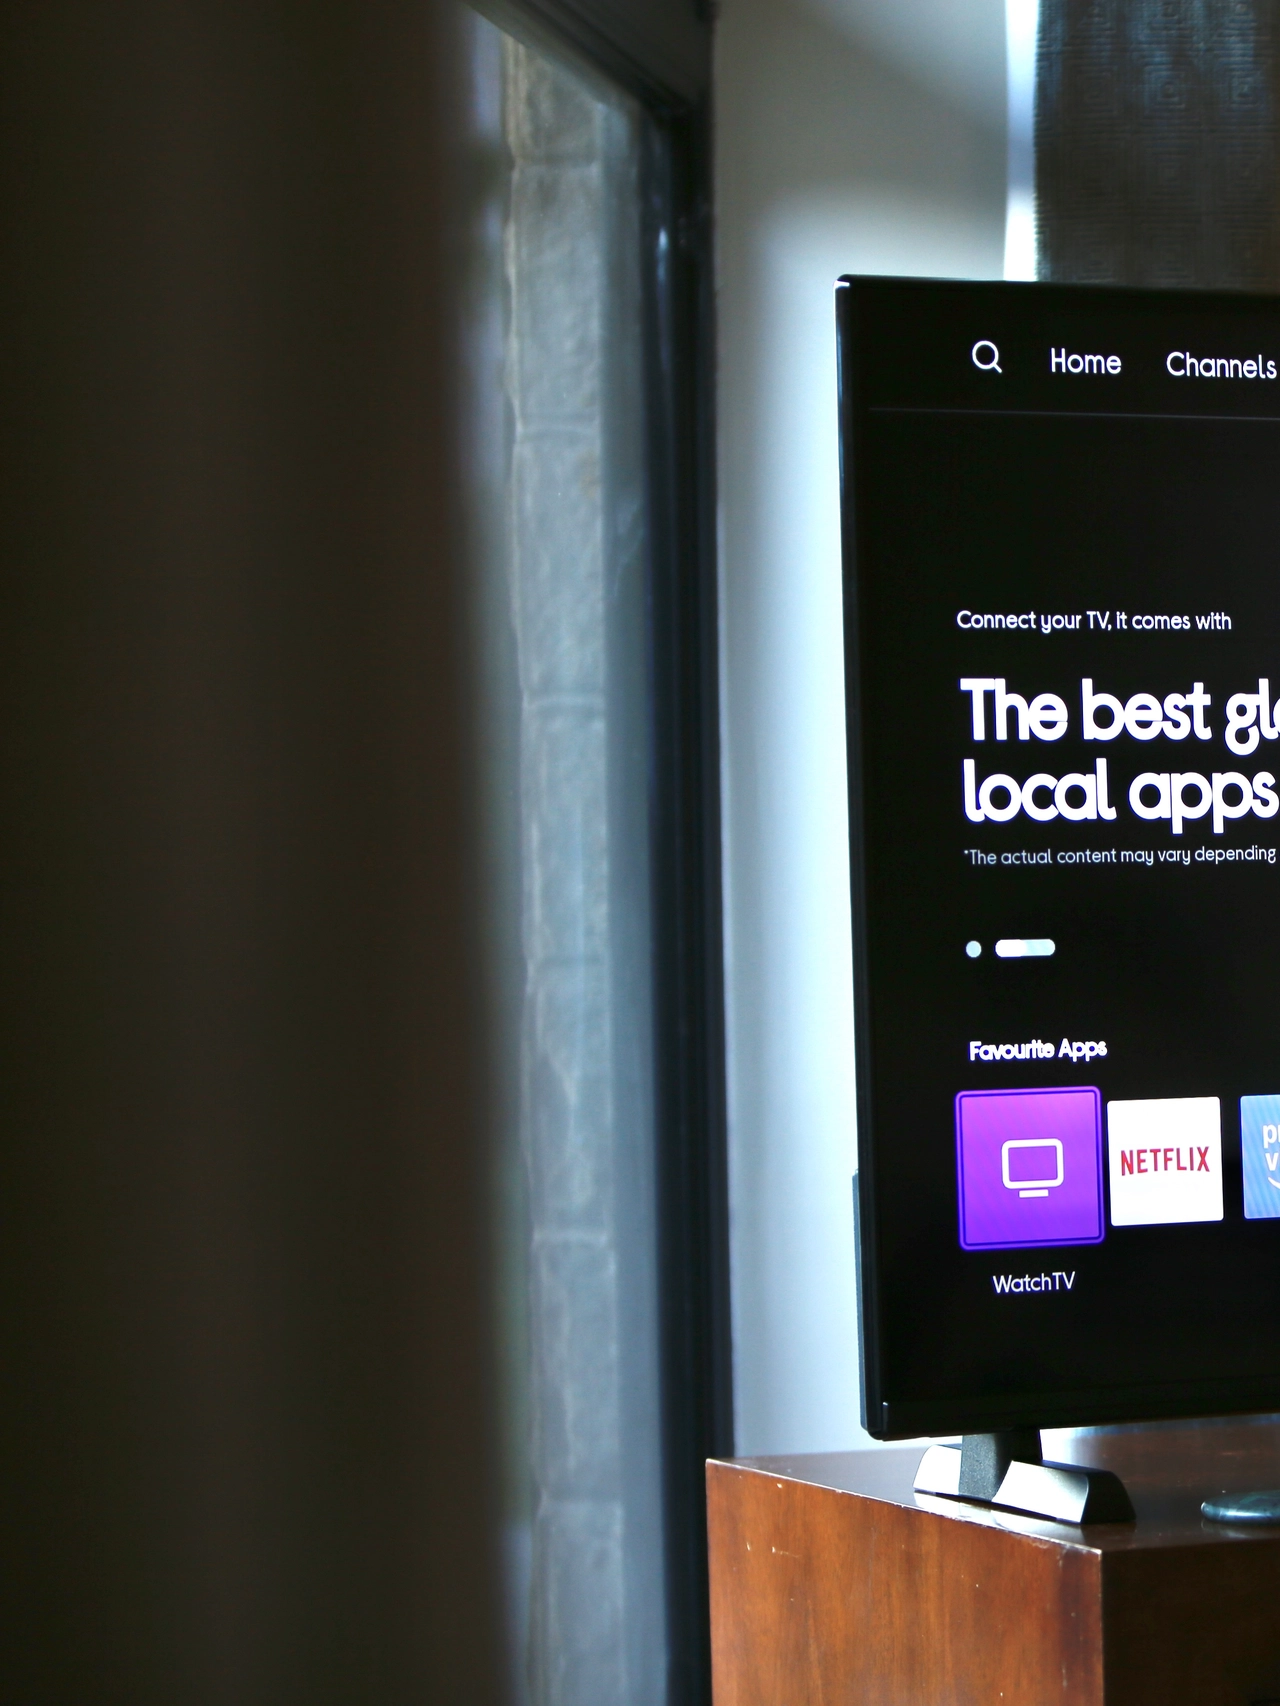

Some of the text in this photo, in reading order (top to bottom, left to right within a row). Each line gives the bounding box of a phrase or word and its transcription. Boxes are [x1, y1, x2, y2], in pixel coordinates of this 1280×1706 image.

[1050, 347, 1122, 375] Home
[1166, 351, 1278, 380] Channels
[956, 609, 1233, 634] Connect your TV, it comes with
[959, 677, 1069, 742] The
[1081, 677, 1213, 741] best
[963, 757, 1280, 835] local apps
[1000, 847, 1053, 865] actual
[1056, 847, 1118, 864] content
[1120, 850, 1154, 867] may
[1157, 849, 1191, 867] vary
[1194, 844, 1277, 866] depending
[968, 1037, 1108, 1063] Favourite Apps
[1120, 1146, 1210, 1176] NETFLIX
